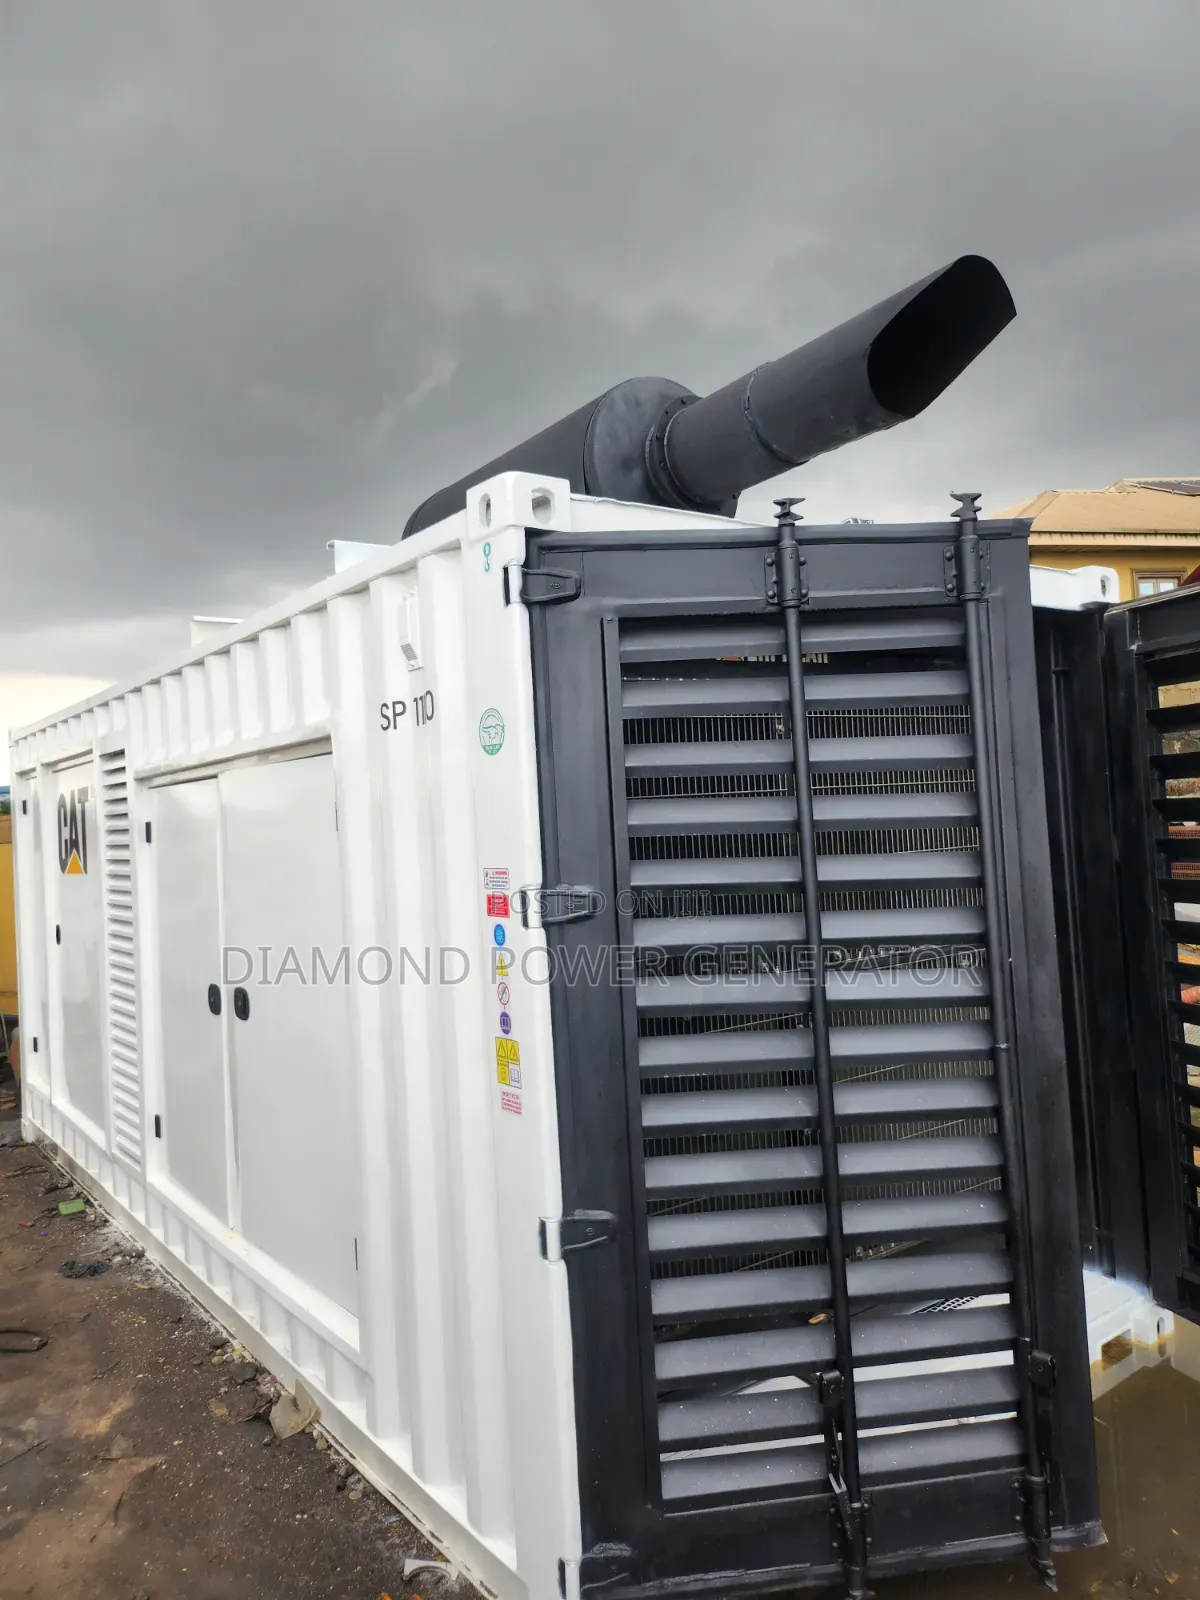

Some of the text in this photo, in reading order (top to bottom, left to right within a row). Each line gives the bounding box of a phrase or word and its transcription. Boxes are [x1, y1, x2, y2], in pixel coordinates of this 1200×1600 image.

[380, 690, 434, 731] SP 110
[58, 786, 88, 875] CAT
